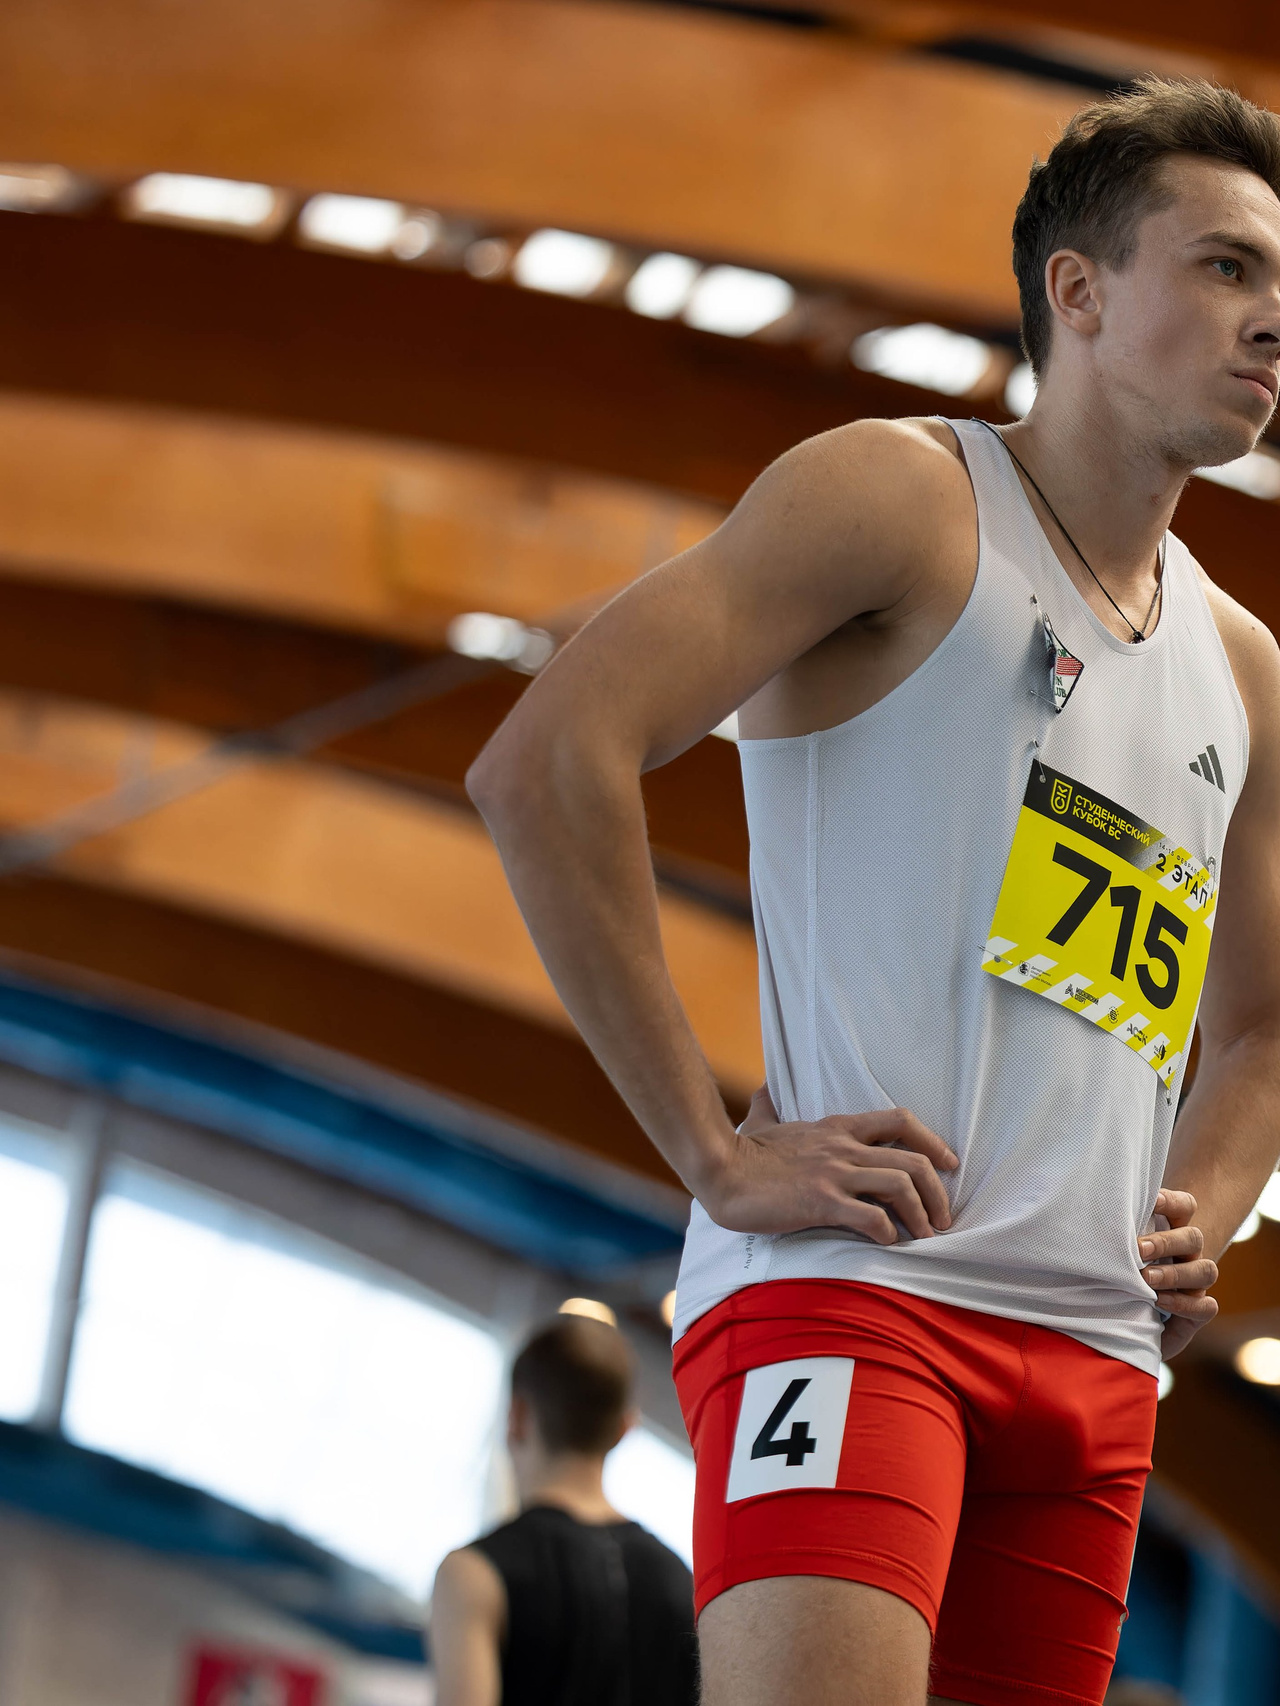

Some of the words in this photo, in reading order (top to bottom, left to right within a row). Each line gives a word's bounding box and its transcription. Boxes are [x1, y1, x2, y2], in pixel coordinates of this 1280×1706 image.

[1072, 806, 1107, 833] КУБОК
[1107, 825, 1122, 840] БС
[1075, 794, 1151, 846] СТУДЕНЧЕСКИЙ
[1155, 852, 1167, 873] 2
[1172, 864, 1208, 909] ЭТАП
[1046, 841, 1189, 1010] 715
[750, 1378, 817, 1467] 4
